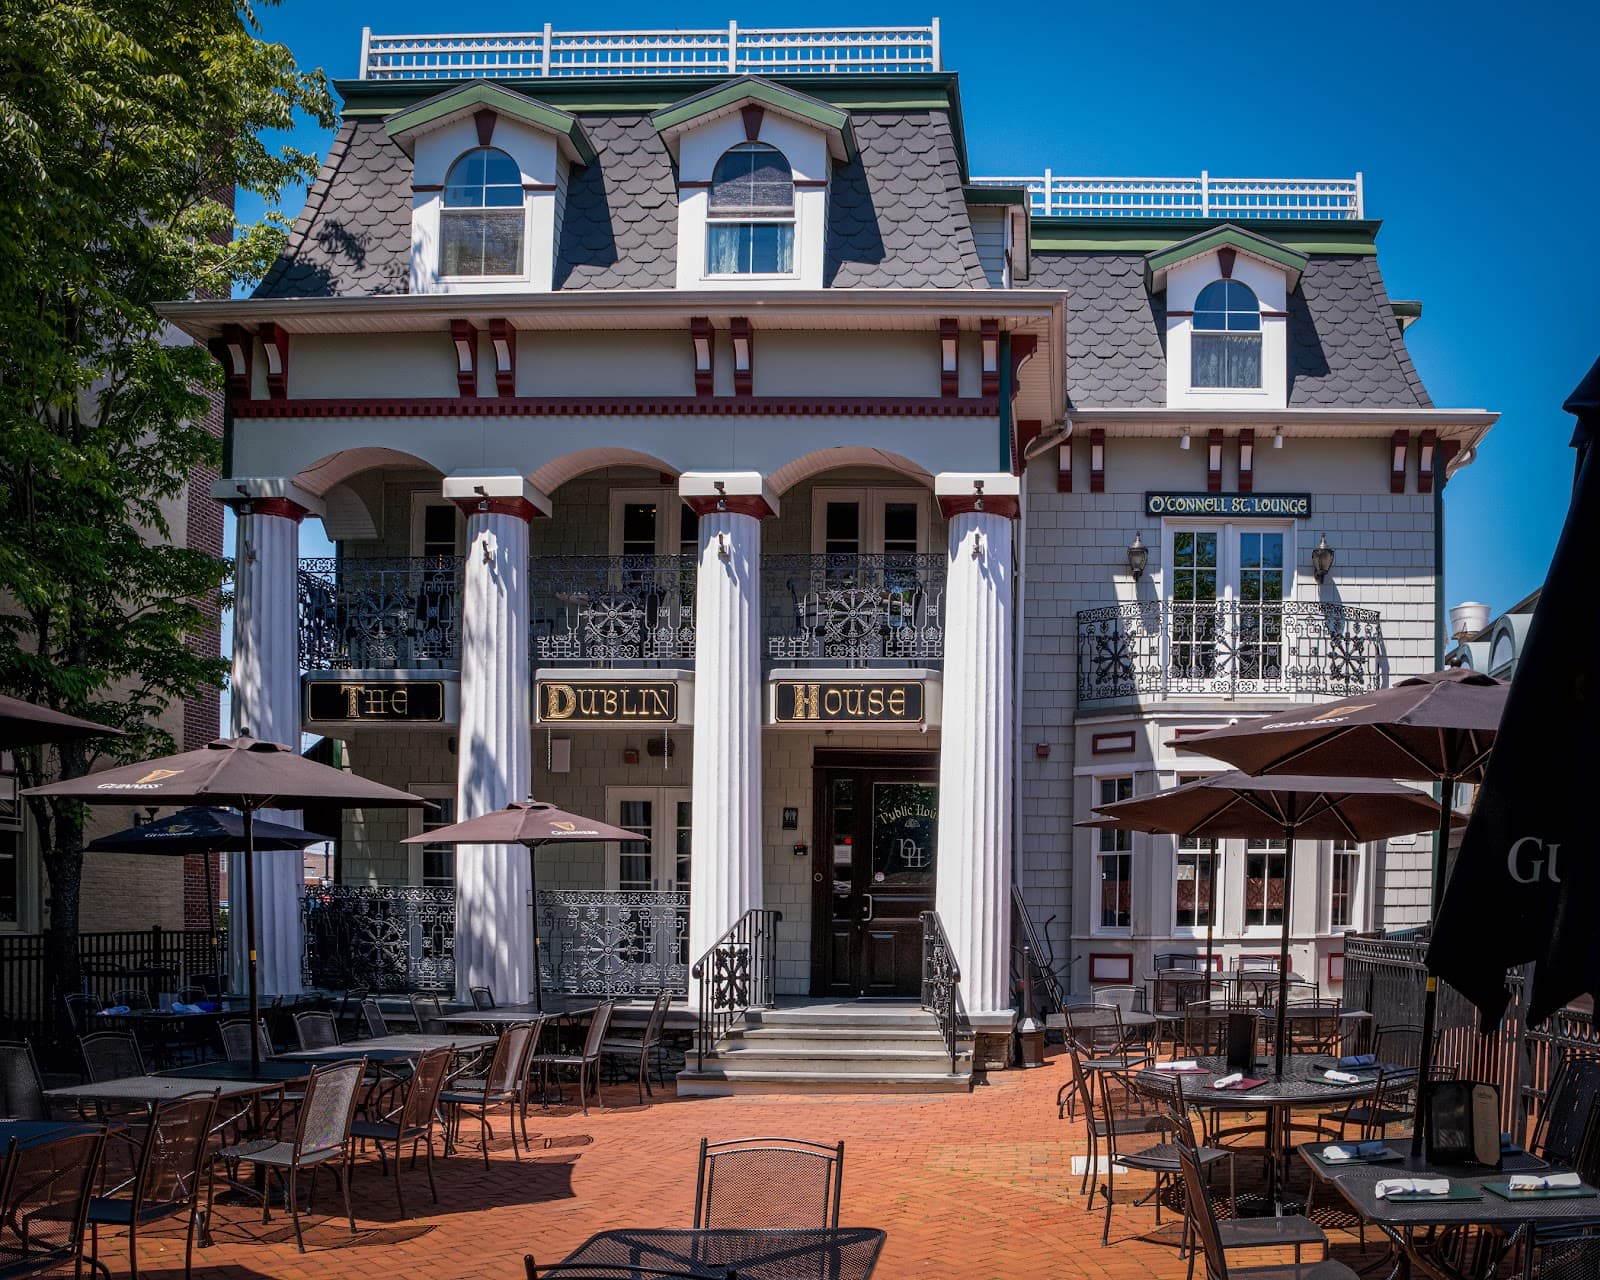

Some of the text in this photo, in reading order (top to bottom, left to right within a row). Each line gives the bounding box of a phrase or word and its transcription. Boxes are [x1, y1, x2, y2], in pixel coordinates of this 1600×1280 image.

[1150, 495, 1307, 513] O'CONNELL ST. LOUNGE
[341, 685, 408, 719] THE
[546, 684, 670, 719] DUBLIN
[793, 684, 905, 719] HOUSE
[880, 805, 912, 824] Public
